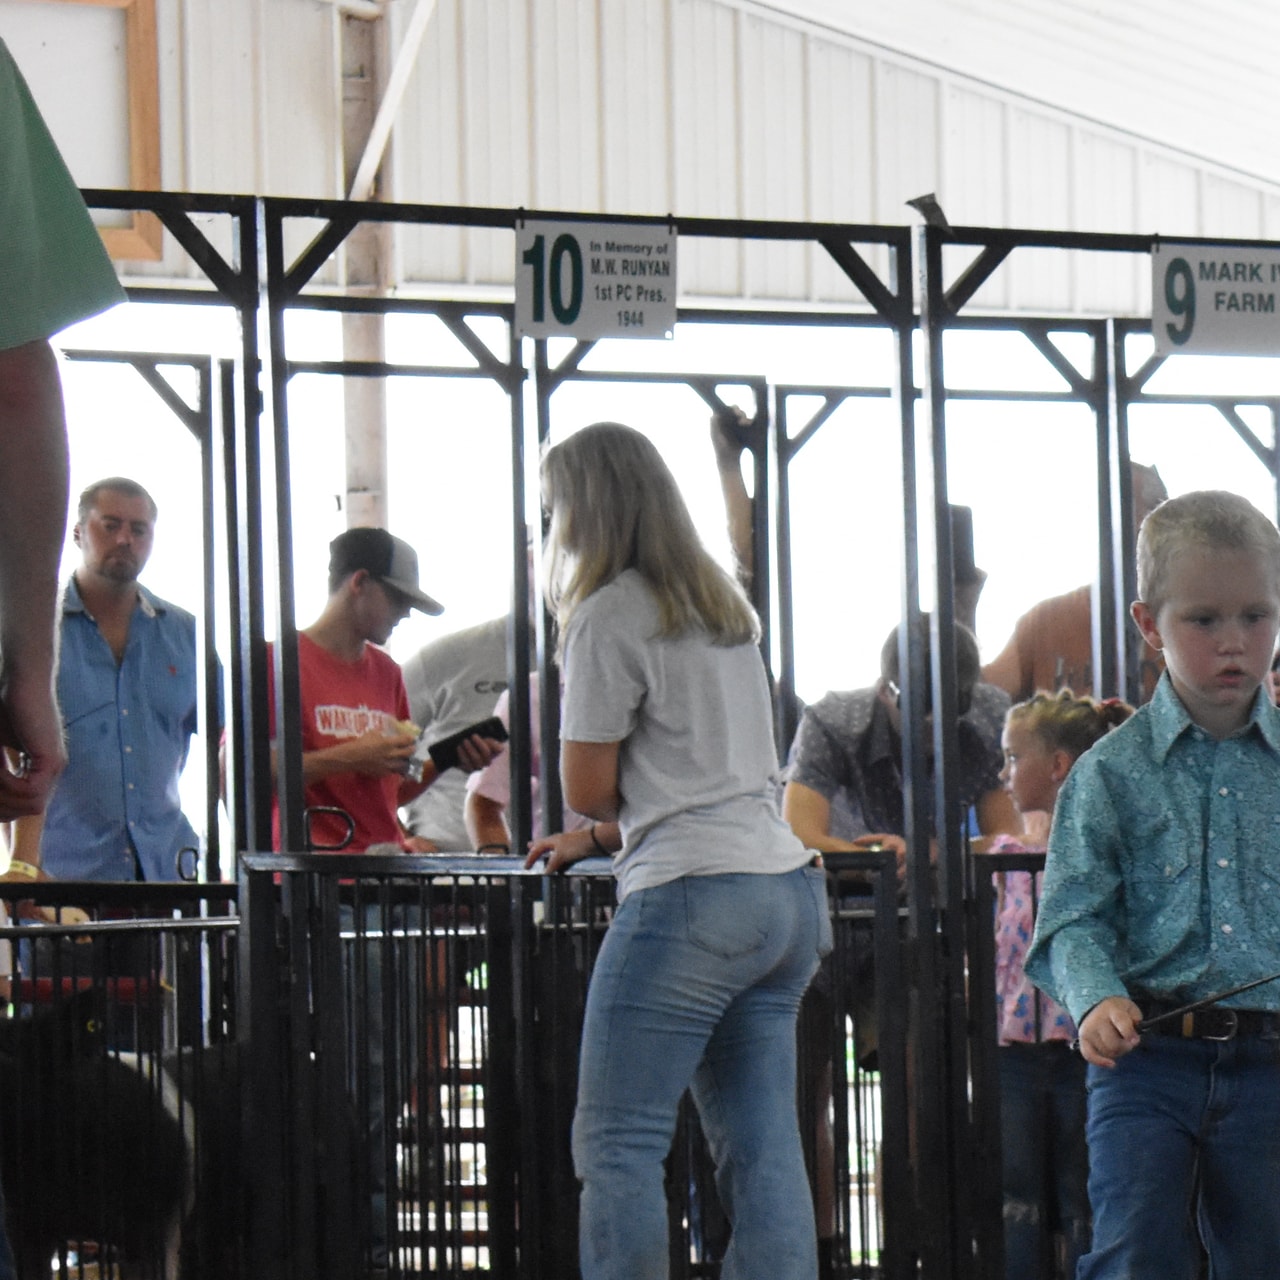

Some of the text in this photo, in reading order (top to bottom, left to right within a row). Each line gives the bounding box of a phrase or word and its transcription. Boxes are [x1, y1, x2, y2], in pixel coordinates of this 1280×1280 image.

[590, 241, 668, 257] In Memory of
[591, 258, 670, 277] M.W. RUNYAN
[1199, 261, 1263, 283] MARK
[522, 233, 584, 326] 10
[595, 284, 667, 303] 1st PC Pres.
[1164, 257, 1196, 347] 9
[1215, 291, 1275, 314] FARM
[617, 310, 644, 327] 1944
